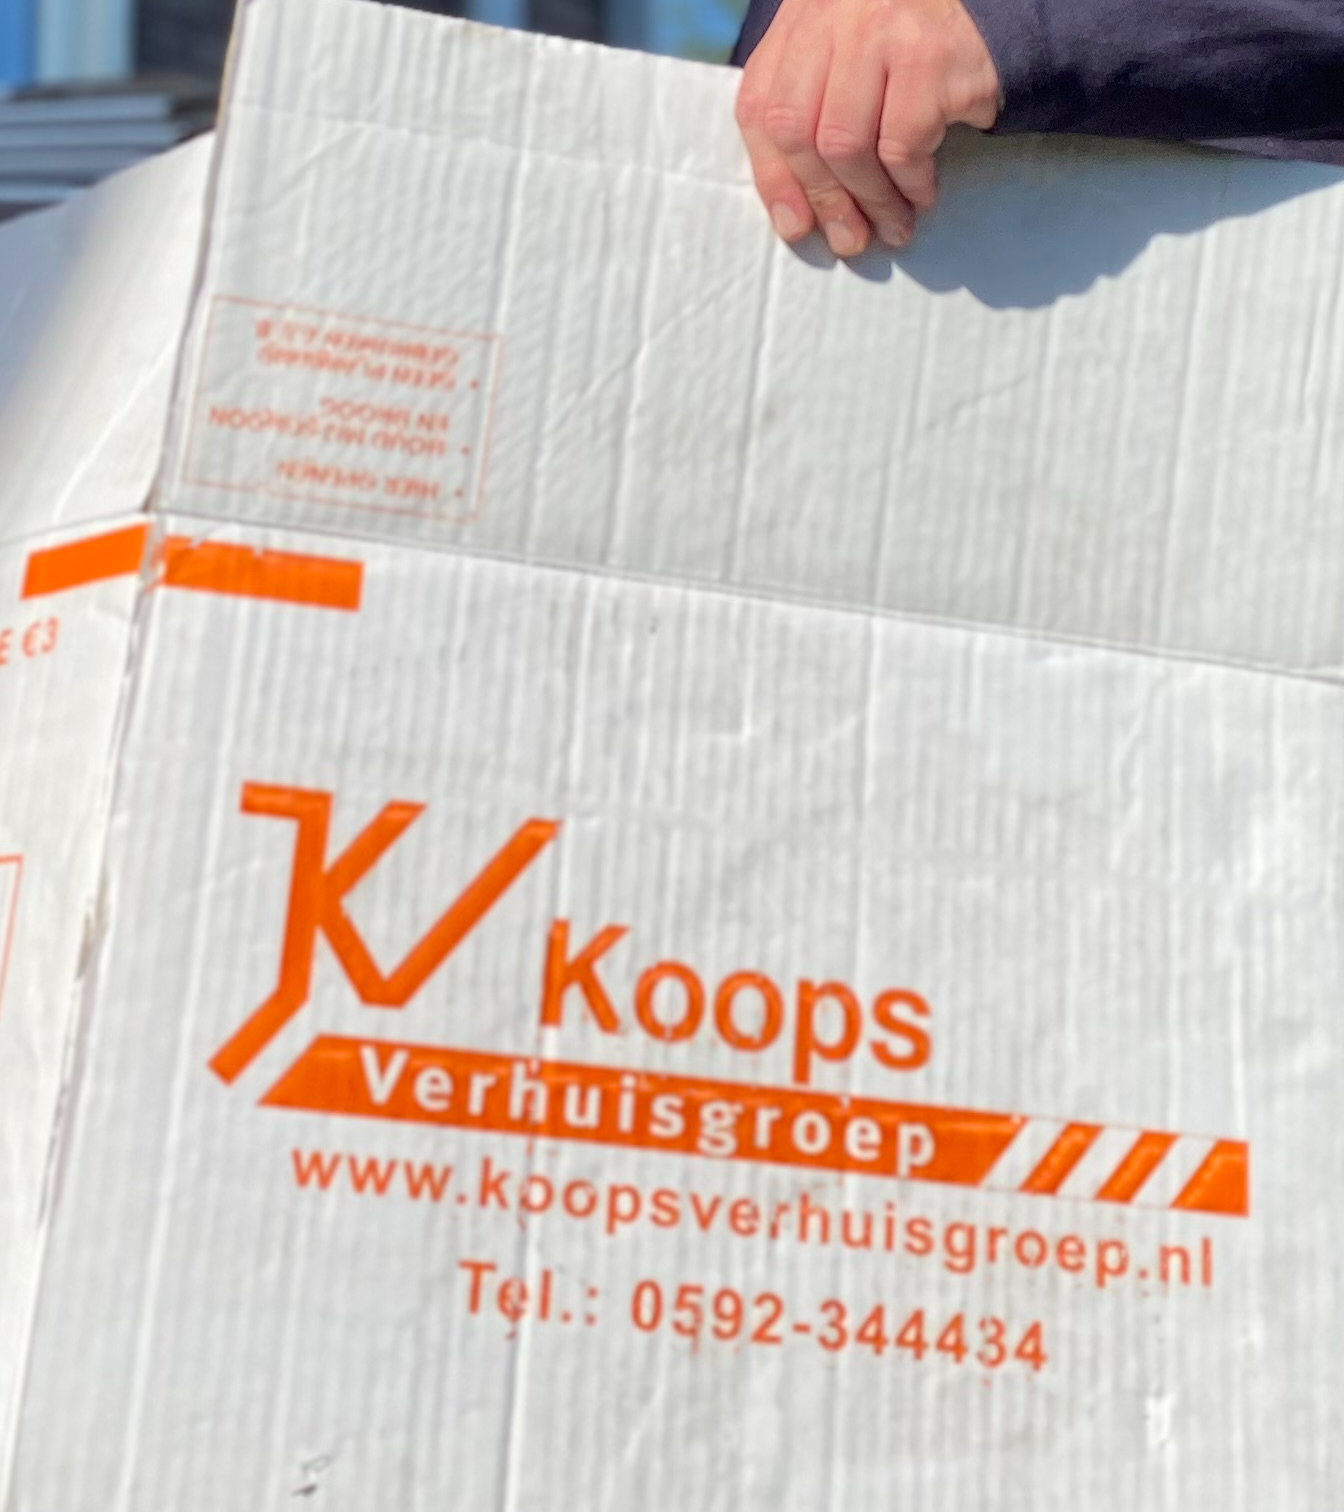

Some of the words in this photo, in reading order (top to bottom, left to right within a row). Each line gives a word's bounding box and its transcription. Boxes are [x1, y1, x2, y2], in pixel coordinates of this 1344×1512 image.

[539, 918, 932, 1085] Koops
[359, 1044, 935, 1176] Verhuisgroep
[291, 1147, 1213, 1290] www.koopsverhuisgroep.nl
[458, 1259, 598, 1326] Tel.:
[630, 1278, 1049, 1373] 0592-344434
